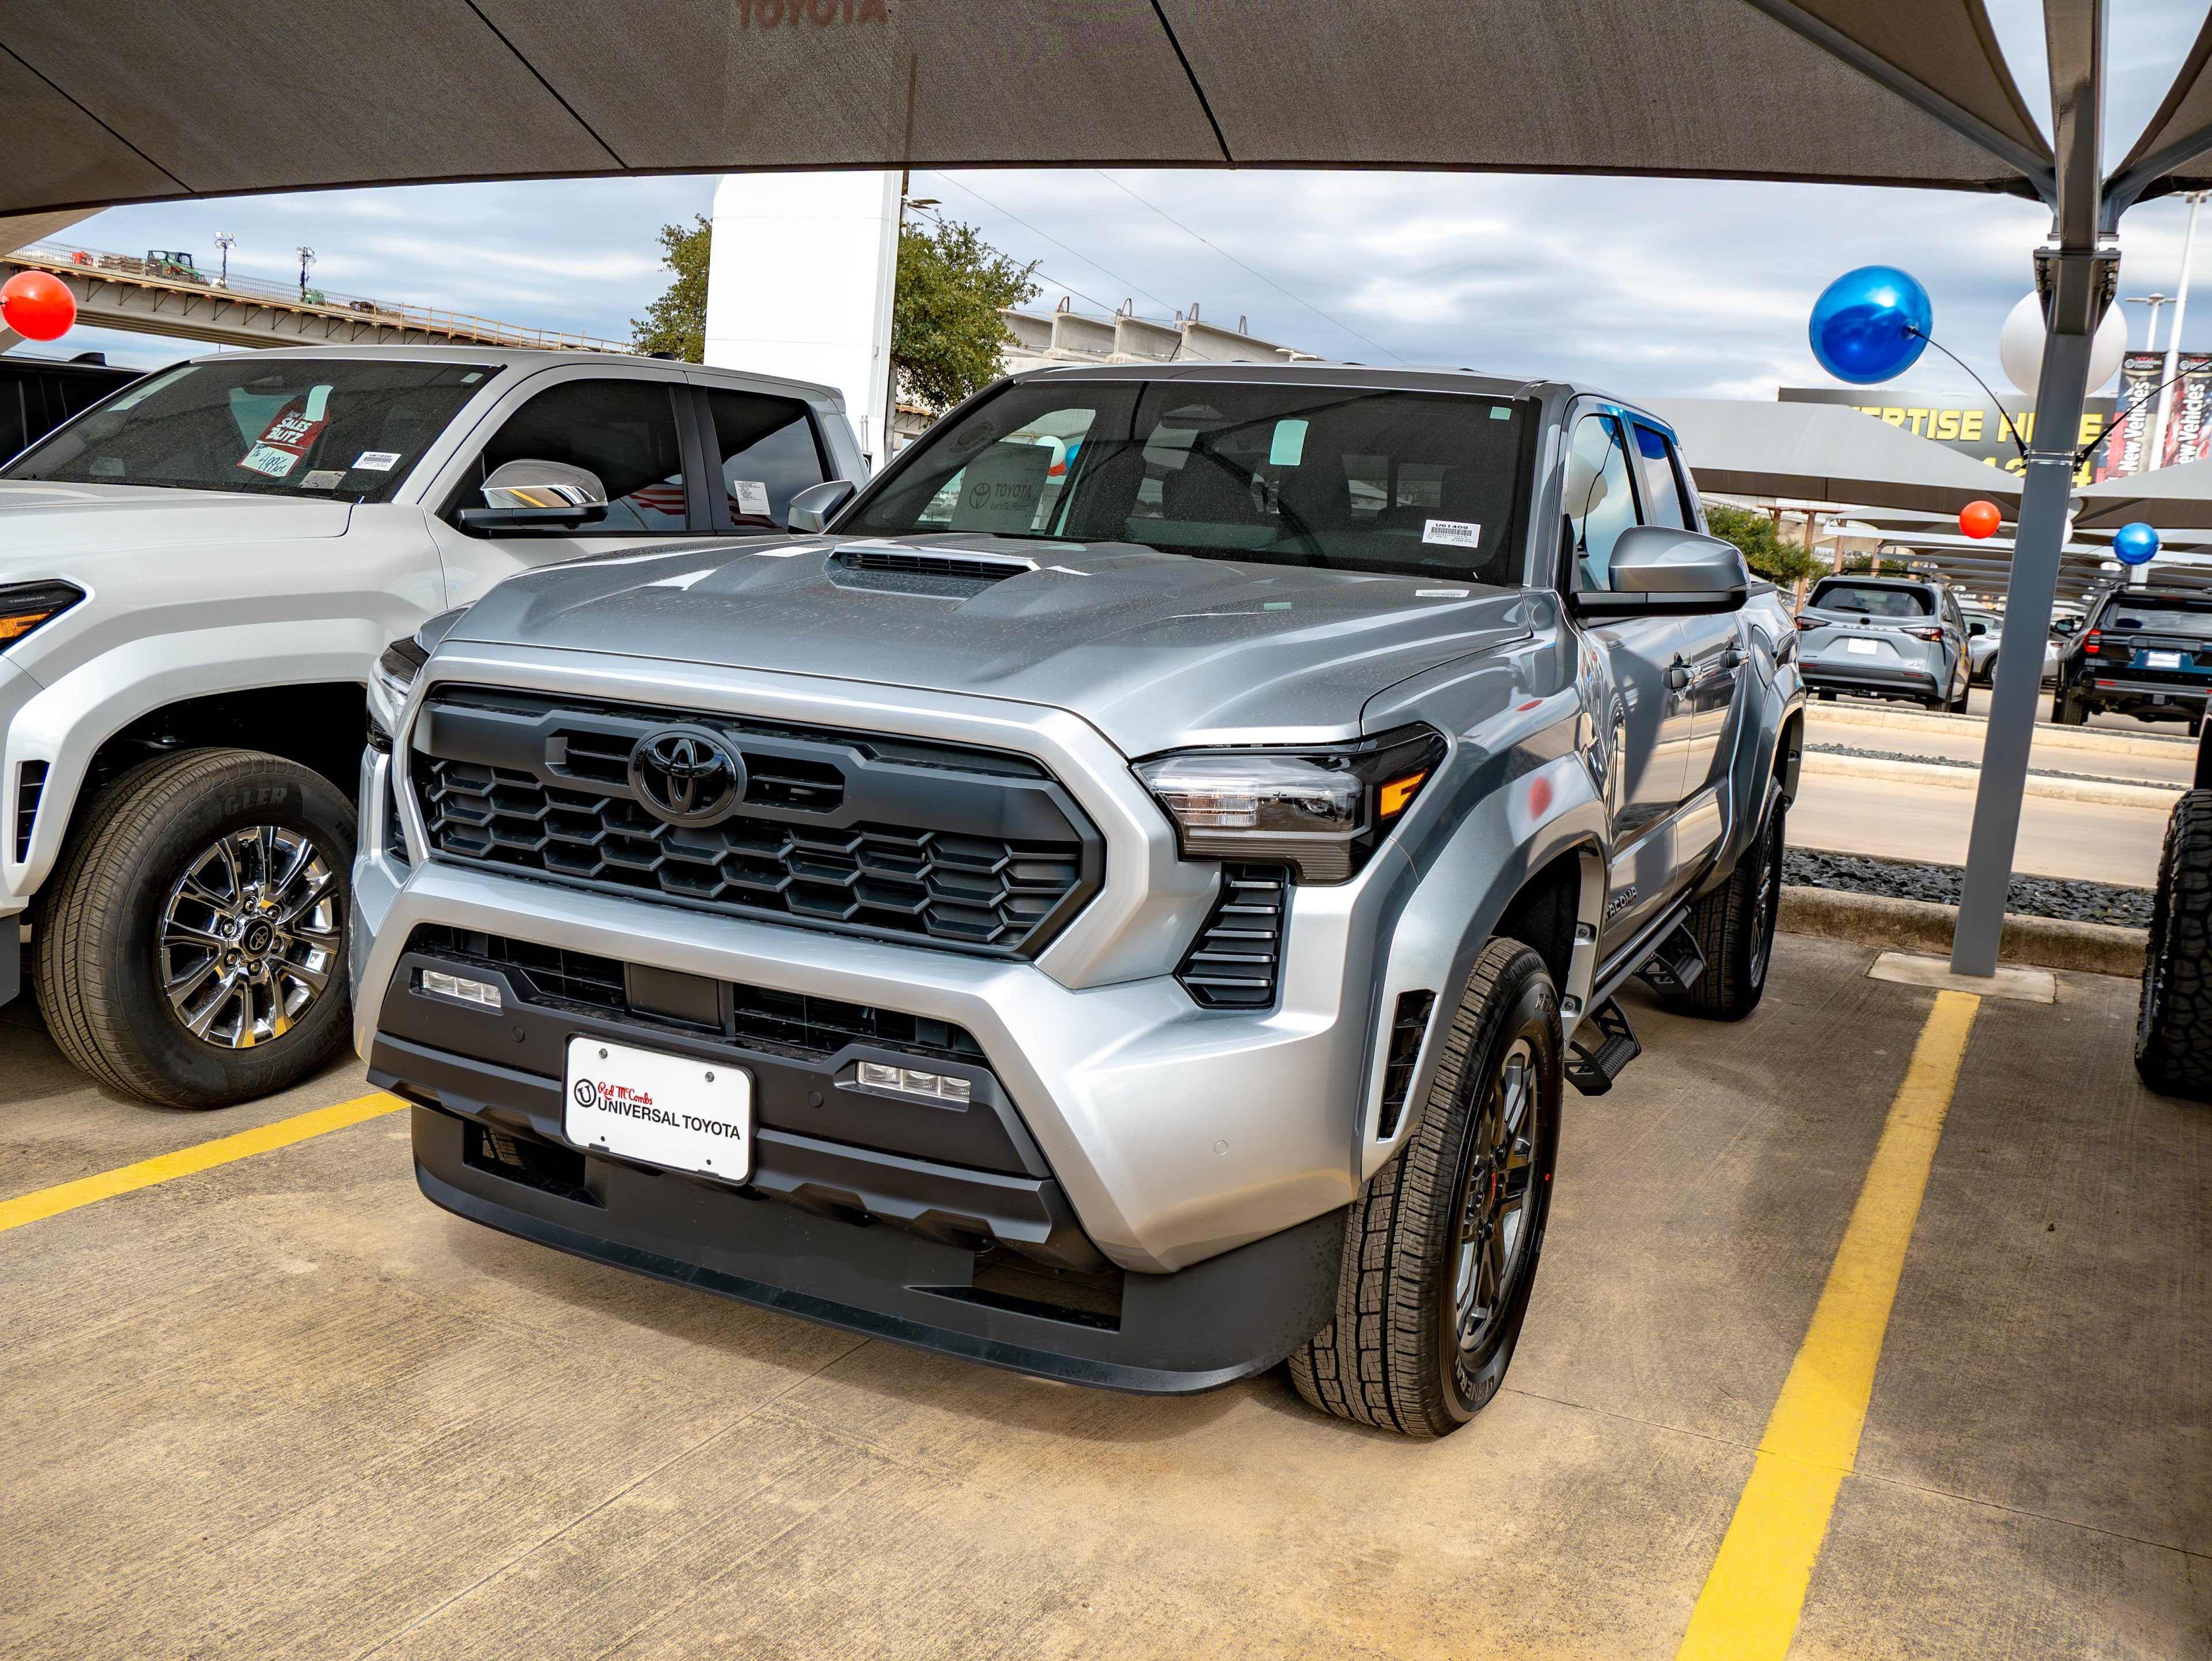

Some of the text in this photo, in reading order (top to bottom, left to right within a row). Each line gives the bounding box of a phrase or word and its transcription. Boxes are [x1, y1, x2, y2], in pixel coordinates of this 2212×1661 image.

[2123, 381, 2151, 440] Vehicles
[2178, 383, 2206, 442] Vehicles
[266, 427, 305, 444] BLITZ
[277, 417, 313, 432] SALES
[2118, 440, 2142, 471] New
[2178, 442, 2198, 464] ew
[995, 483, 1032, 498] TOYOTA
[1604, 887, 1638, 921] TACOMA
[598, 1081, 614, 1100] Red
[615, 1085, 653, 1105] McCombs
[598, 1097, 741, 1140] UNIVERSAL TOYOTA
